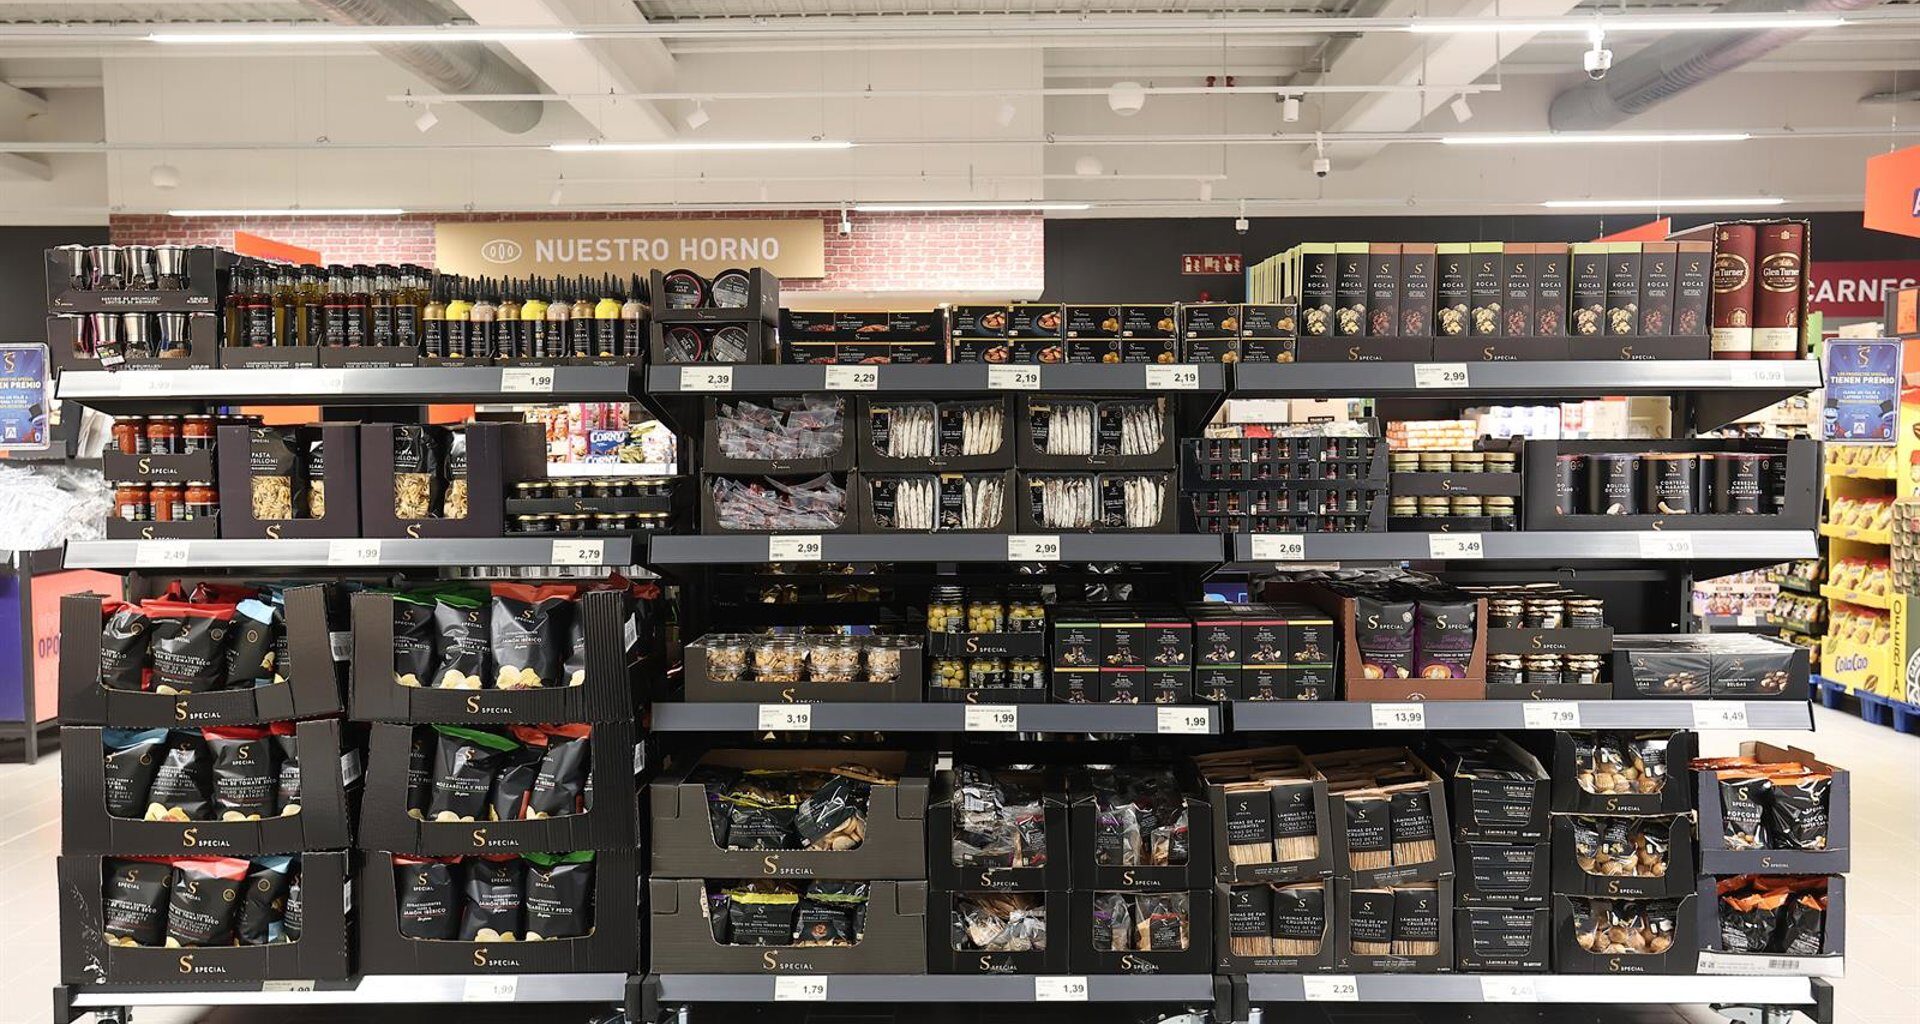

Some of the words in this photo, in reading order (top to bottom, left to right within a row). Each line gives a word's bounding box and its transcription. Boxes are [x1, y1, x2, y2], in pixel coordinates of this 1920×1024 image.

[535, 238, 670, 263] NUESTRO
[680, 237, 780, 261] HORNO
[1720, 268, 1744, 276] Turner
[1763, 268, 1780, 276] Glen
[1780, 268, 1799, 276] Turne
[1349, 346, 1360, 361] S
[1483, 346, 1495, 361] S
[1621, 346, 1633, 360] S
[530, 374, 552, 386] 1,99
[708, 375, 730, 386] 2,39
[853, 373, 876, 384] 2,29
[1016, 374, 1038, 385] 2,19
[1174, 373, 1196, 384] 2,19
[1443, 372, 1466, 382] 2,99
[1830, 376, 1861, 384] TIENEN
[1862, 376, 1895, 384] PREMIO
[11, 381, 42, 389] PREMIO
[590, 432, 625, 443] CORNY
[138, 457, 151, 474] S
[1442, 479, 1451, 491] S
[574, 500, 583, 511] S
[797, 544, 820, 555] 2,99
[1035, 544, 1057, 555] 2,99
[1279, 544, 1302, 555] 2,69
[1458, 542, 1480, 553] 3,49
[164, 550, 186, 560] 2,49
[358, 549, 378, 560] 1,99
[578, 550, 601, 560] 2,79
[395, 619, 416, 627] SPECIAL
[514, 616, 535, 624] SPECIAL
[1368, 614, 1380, 630] S
[1436, 614, 1448, 630] S
[966, 636, 980, 653] S
[1532, 635, 1543, 649] S
[1893, 600, 1902, 693] OFERTA
[1835, 653, 1868, 673] ColaCao
[466, 695, 481, 714] S
[175, 700, 188, 721] S
[190, 712, 221, 720] SPECIAL
[786, 714, 809, 725] 3,19
[993, 714, 1015, 725] 1,99
[1184, 717, 1206, 728] 1,99
[1395, 713, 1422, 723] 13,99
[1552, 712, 1574, 723] 7,99
[1722, 712, 1745, 722] 4,49
[436, 781, 469, 790] MOZZARELLA
[1607, 798, 1618, 811] S
[1727, 810, 1762, 818] POPCORN
[183, 827, 198, 847] S
[472, 828, 487, 847] S
[763, 854, 780, 875] S
[1762, 856, 1771, 868] S
[980, 868, 993, 886] S
[1123, 870, 1135, 886] S
[1608, 880, 1620, 894] S
[473, 947, 488, 967] S
[762, 950, 778, 971] S
[980, 954, 992, 971] S
[1121, 954, 1133, 970] S
[179, 954, 194, 974] S
[1609, 958, 1621, 972] S
[803, 985, 824, 995] 1,79
[1063, 984, 1085, 995] 1,39
[1333, 984, 1355, 994] 2,29
